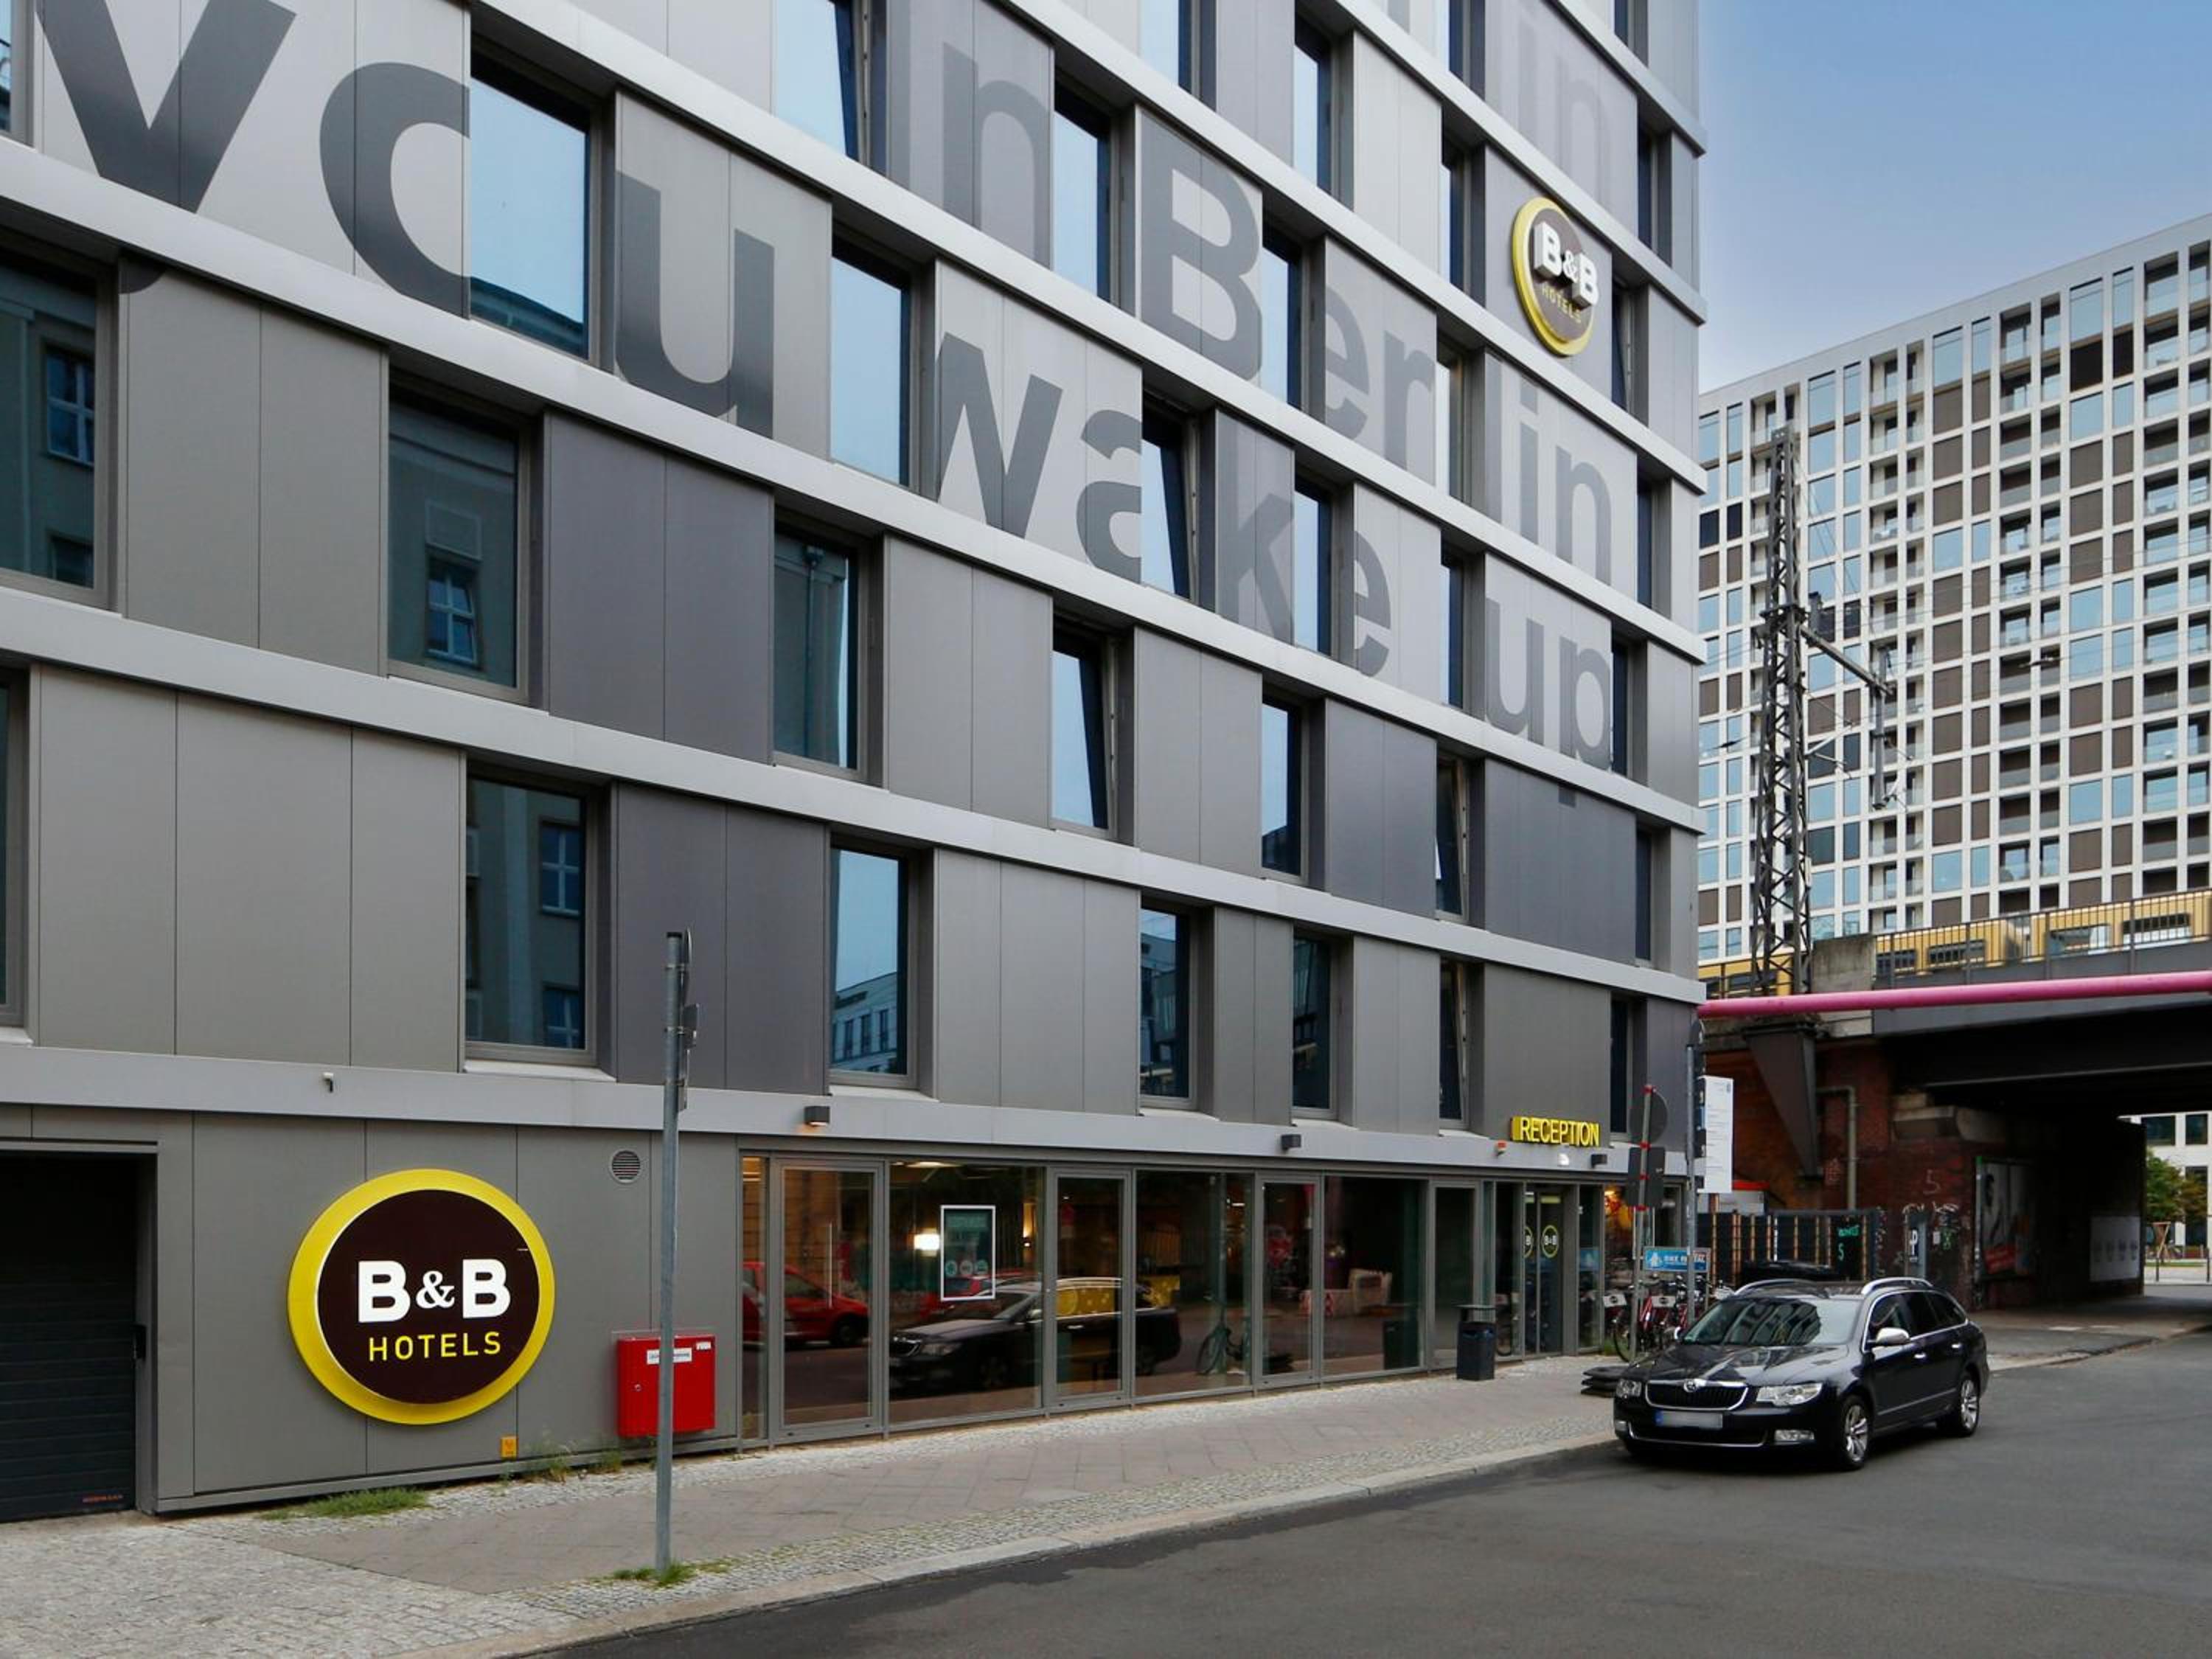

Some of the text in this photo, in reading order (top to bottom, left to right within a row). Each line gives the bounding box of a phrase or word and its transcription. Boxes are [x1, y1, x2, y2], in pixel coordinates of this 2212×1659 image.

[1534, 222, 1599, 306] B&B
[1518, 1116, 1599, 1147] RECEPTION
[358, 1259, 511, 1323] B&B
[369, 1332, 501, 1362] HOTELS
